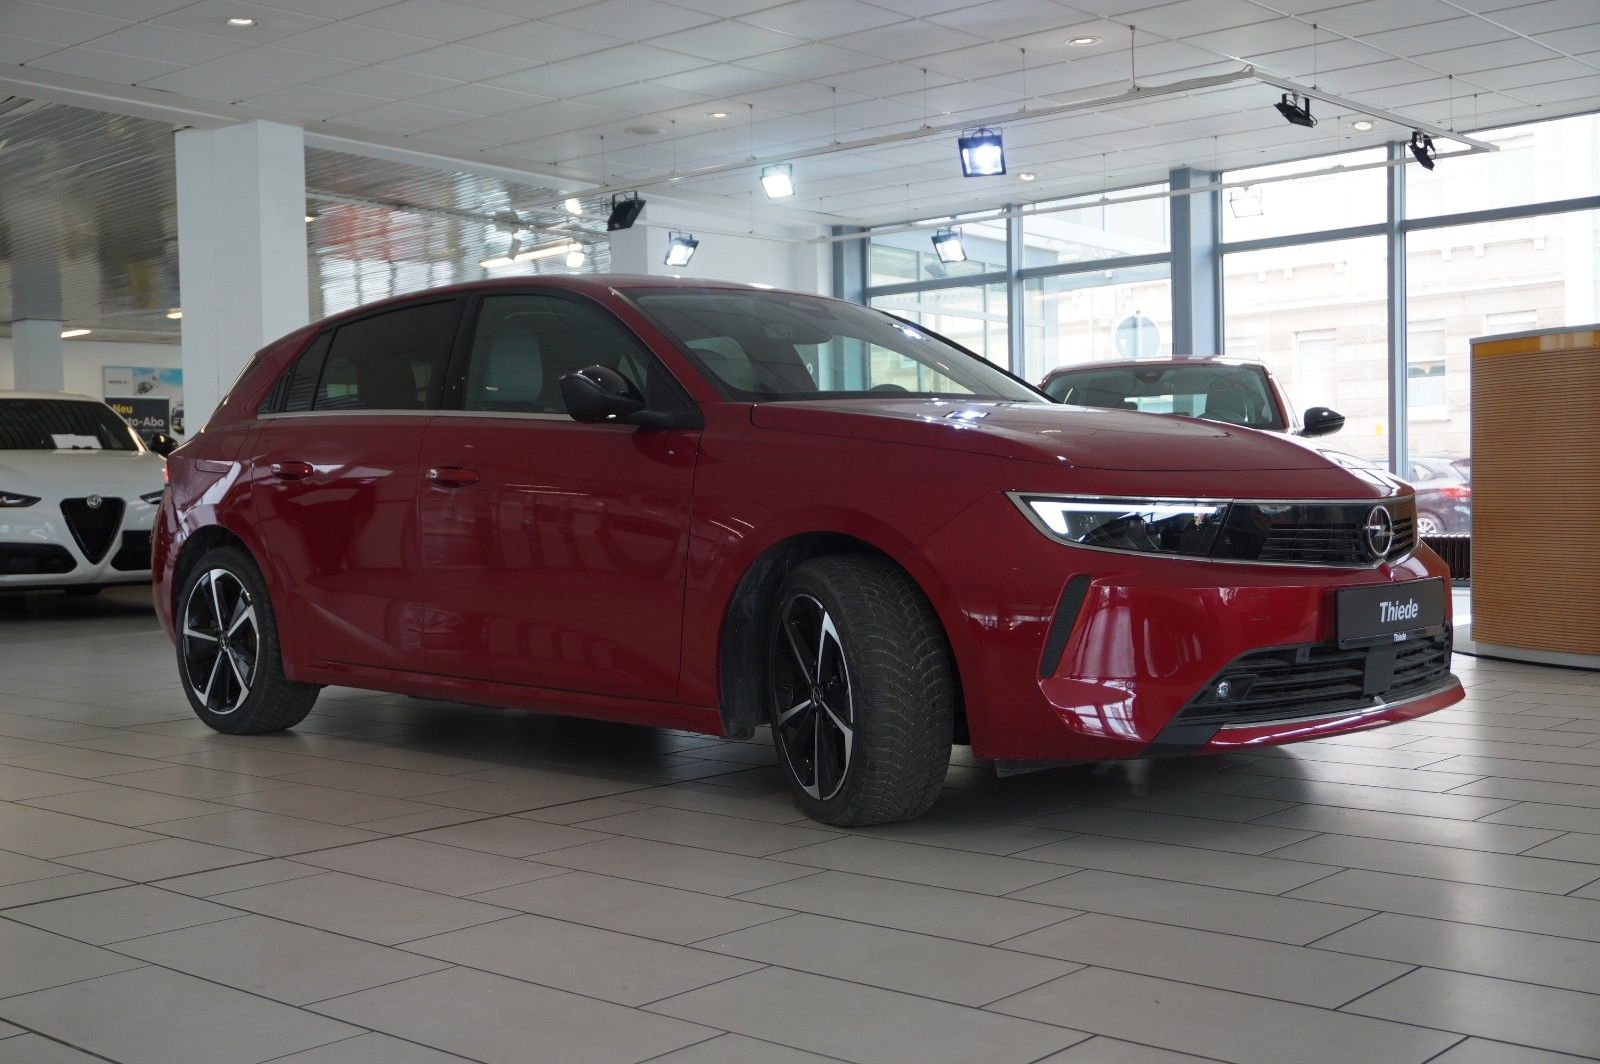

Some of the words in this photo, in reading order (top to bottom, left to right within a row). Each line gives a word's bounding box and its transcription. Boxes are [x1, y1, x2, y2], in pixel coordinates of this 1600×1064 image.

[112, 403, 133, 414] Neu
[126, 416, 164, 427] to-Abo
[1379, 598, 1418, 622] Thiede
[1393, 632, 1407, 642] Thiede
